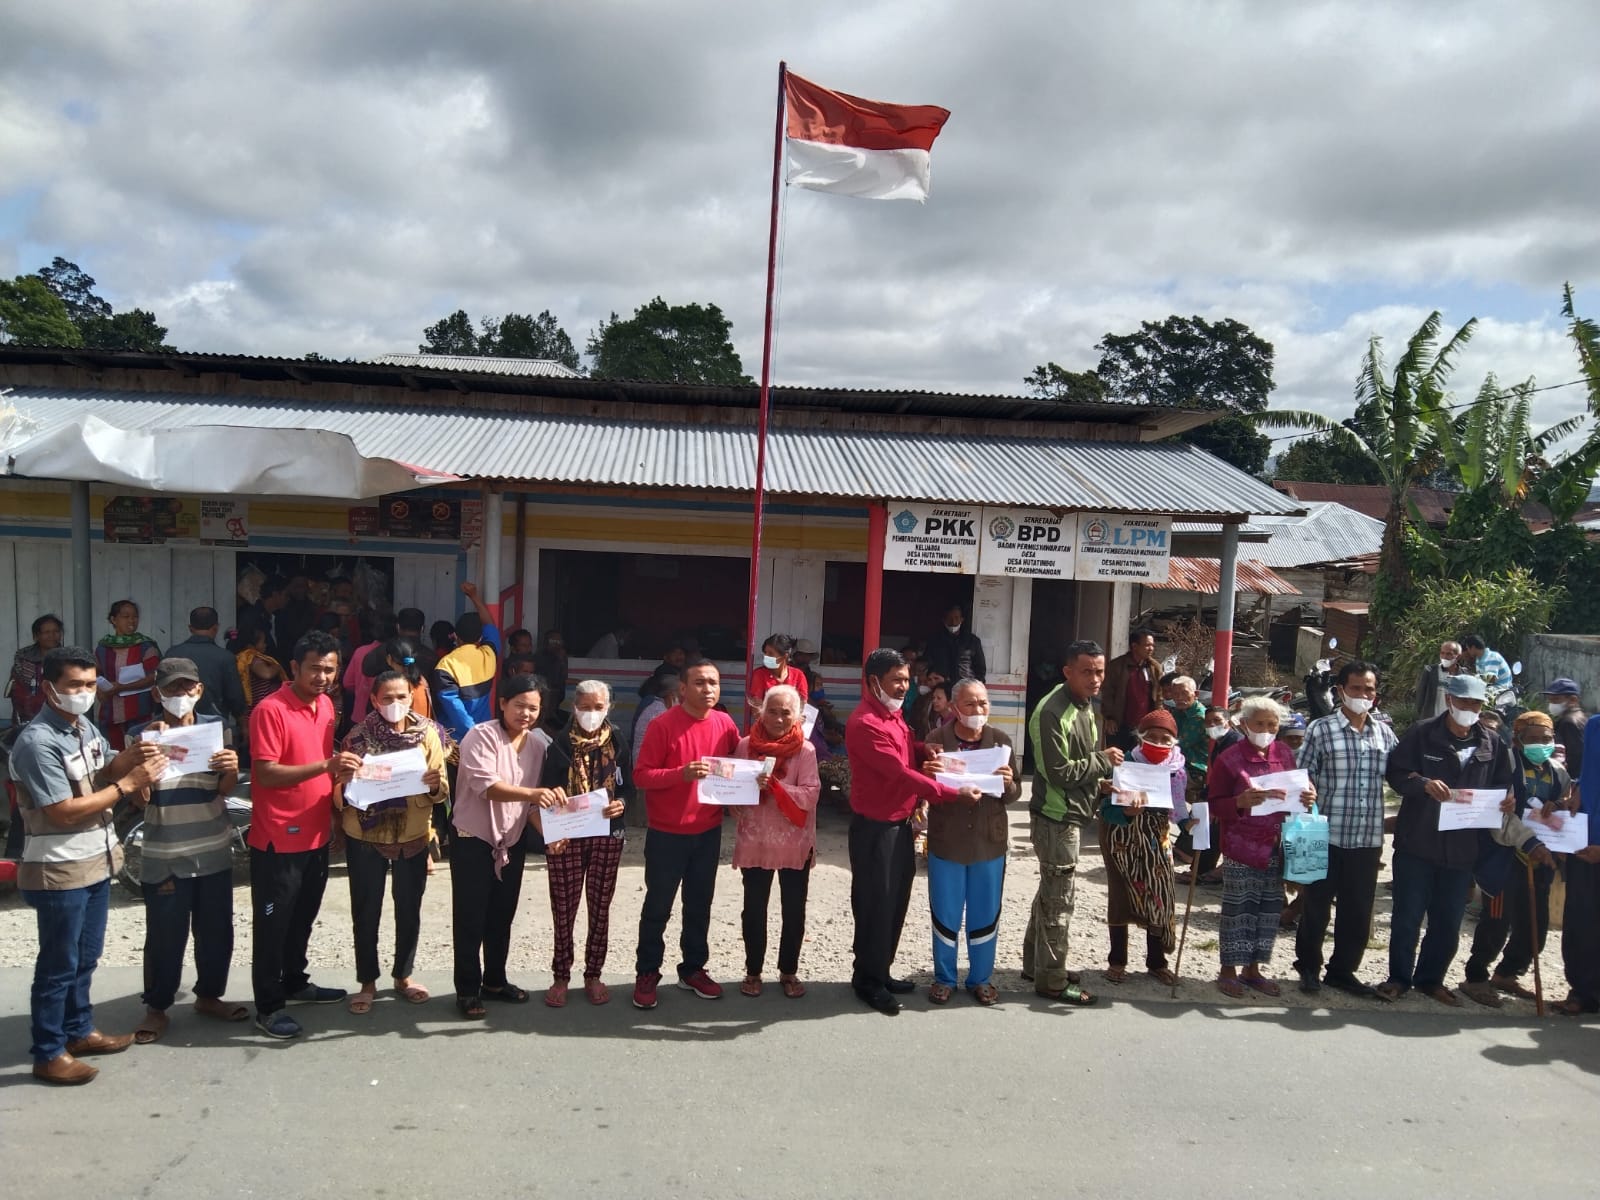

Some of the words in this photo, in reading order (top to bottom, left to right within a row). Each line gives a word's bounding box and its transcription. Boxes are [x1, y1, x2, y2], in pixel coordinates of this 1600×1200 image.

[932, 509, 971, 517] SEKRETARIAT
[925, 518, 974, 537] PKK
[1018, 525, 1060, 542] BPD
[1114, 528, 1166, 547] LPM
[1017, 543, 1071, 552] PERMUSYAWARATAN
[920, 559, 962, 568] PARMONANGAN
